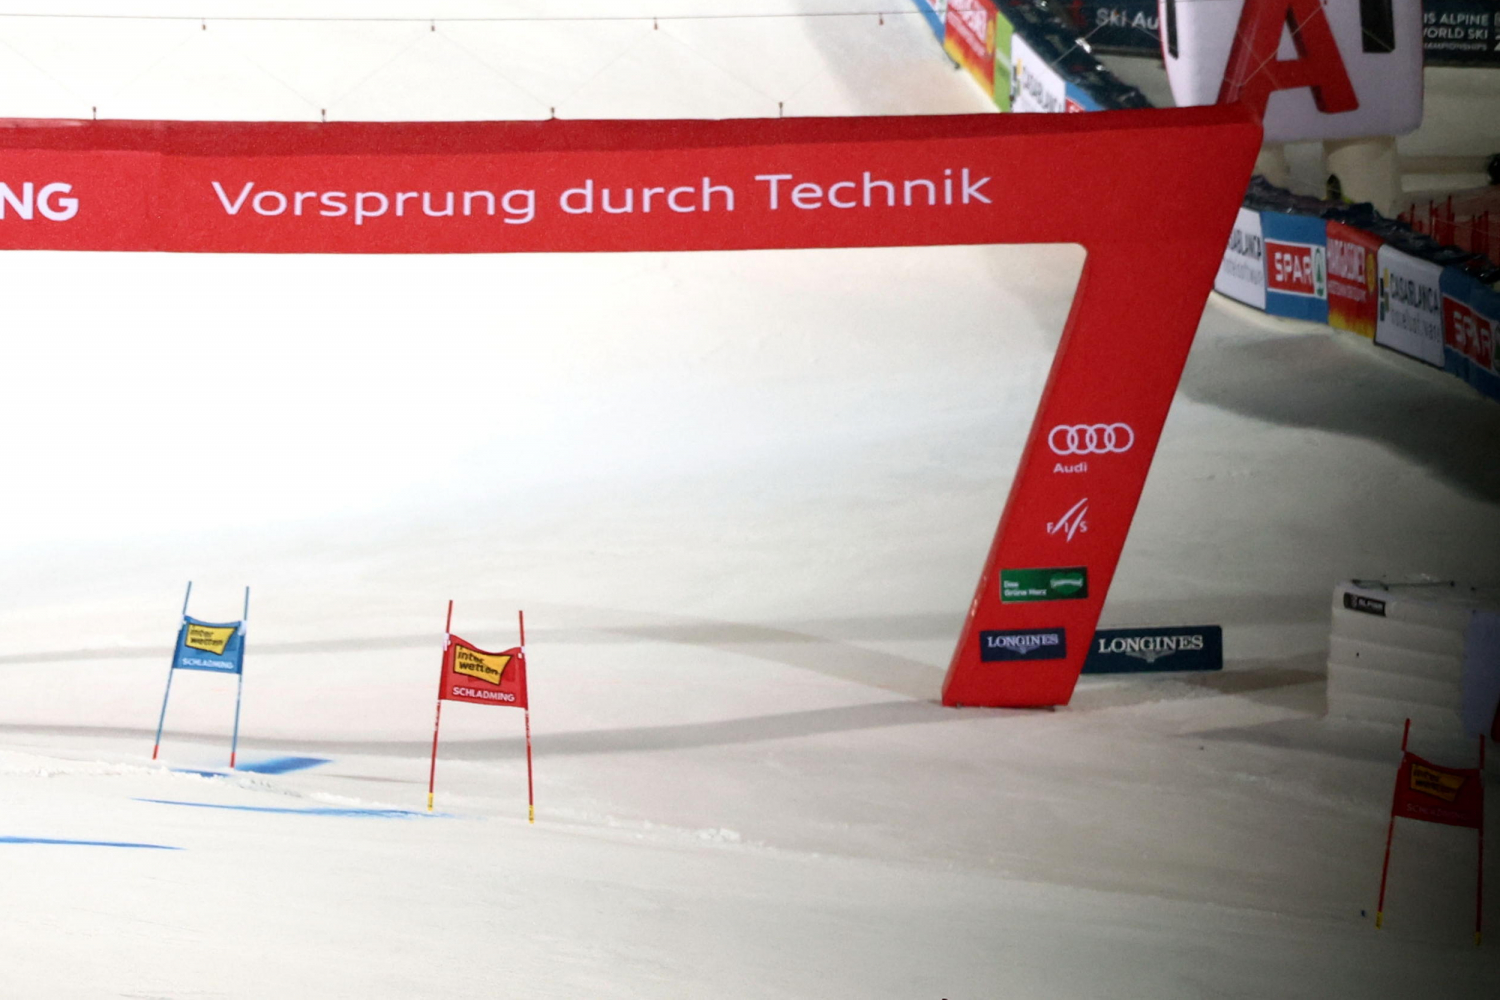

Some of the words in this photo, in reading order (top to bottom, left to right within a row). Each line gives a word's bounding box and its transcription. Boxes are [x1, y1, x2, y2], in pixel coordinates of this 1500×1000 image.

[1440, 12, 1490, 27] ALPINE
[1467, 29, 1489, 40] SKI
[211, 180, 536, 226] Vorsprung
[559, 176, 735, 215] durch
[754, 167, 993, 211] Technik
[1274, 251, 1313, 286] SPAR
[1053, 462, 1088, 474] Audi
[987, 633, 1059, 648] LONGINES
[1098, 634, 1204, 654] LONGINES
[457, 646, 485, 664] inter
[458, 660, 500, 676] wetten
[452, 686, 516, 702] SCHLADMING
